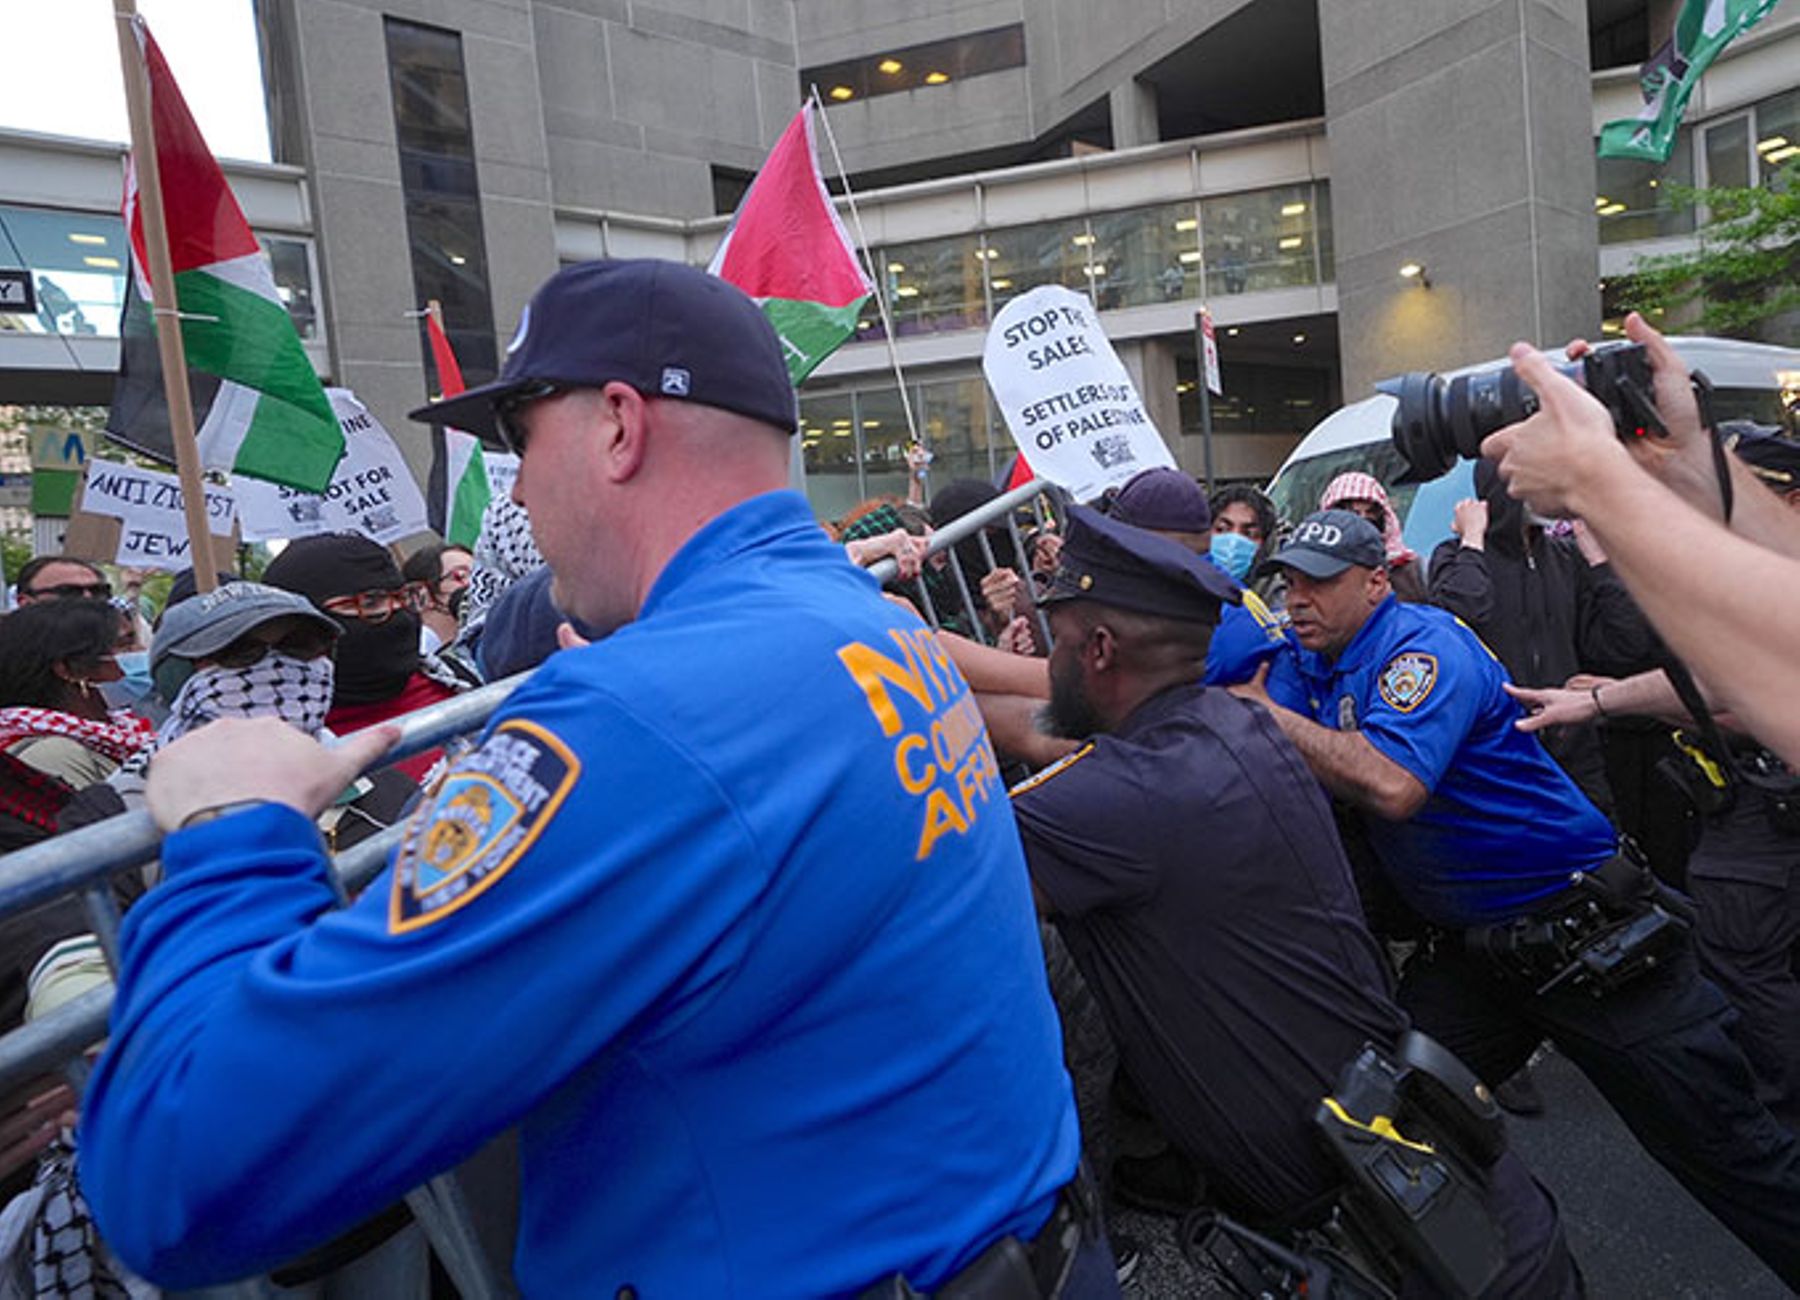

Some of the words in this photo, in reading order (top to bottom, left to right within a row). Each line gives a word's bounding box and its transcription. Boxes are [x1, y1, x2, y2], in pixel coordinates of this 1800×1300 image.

[1003, 310, 1060, 348] STOP
[1035, 425, 1064, 451] OF
[89, 472, 150, 505] ANTI
[152, 481, 236, 518] ZIOIST
[322, 480, 353, 502] OT
[355, 465, 393, 489] FOR
[344, 486, 391, 515] SALE
[124, 530, 190, 557] JEW
